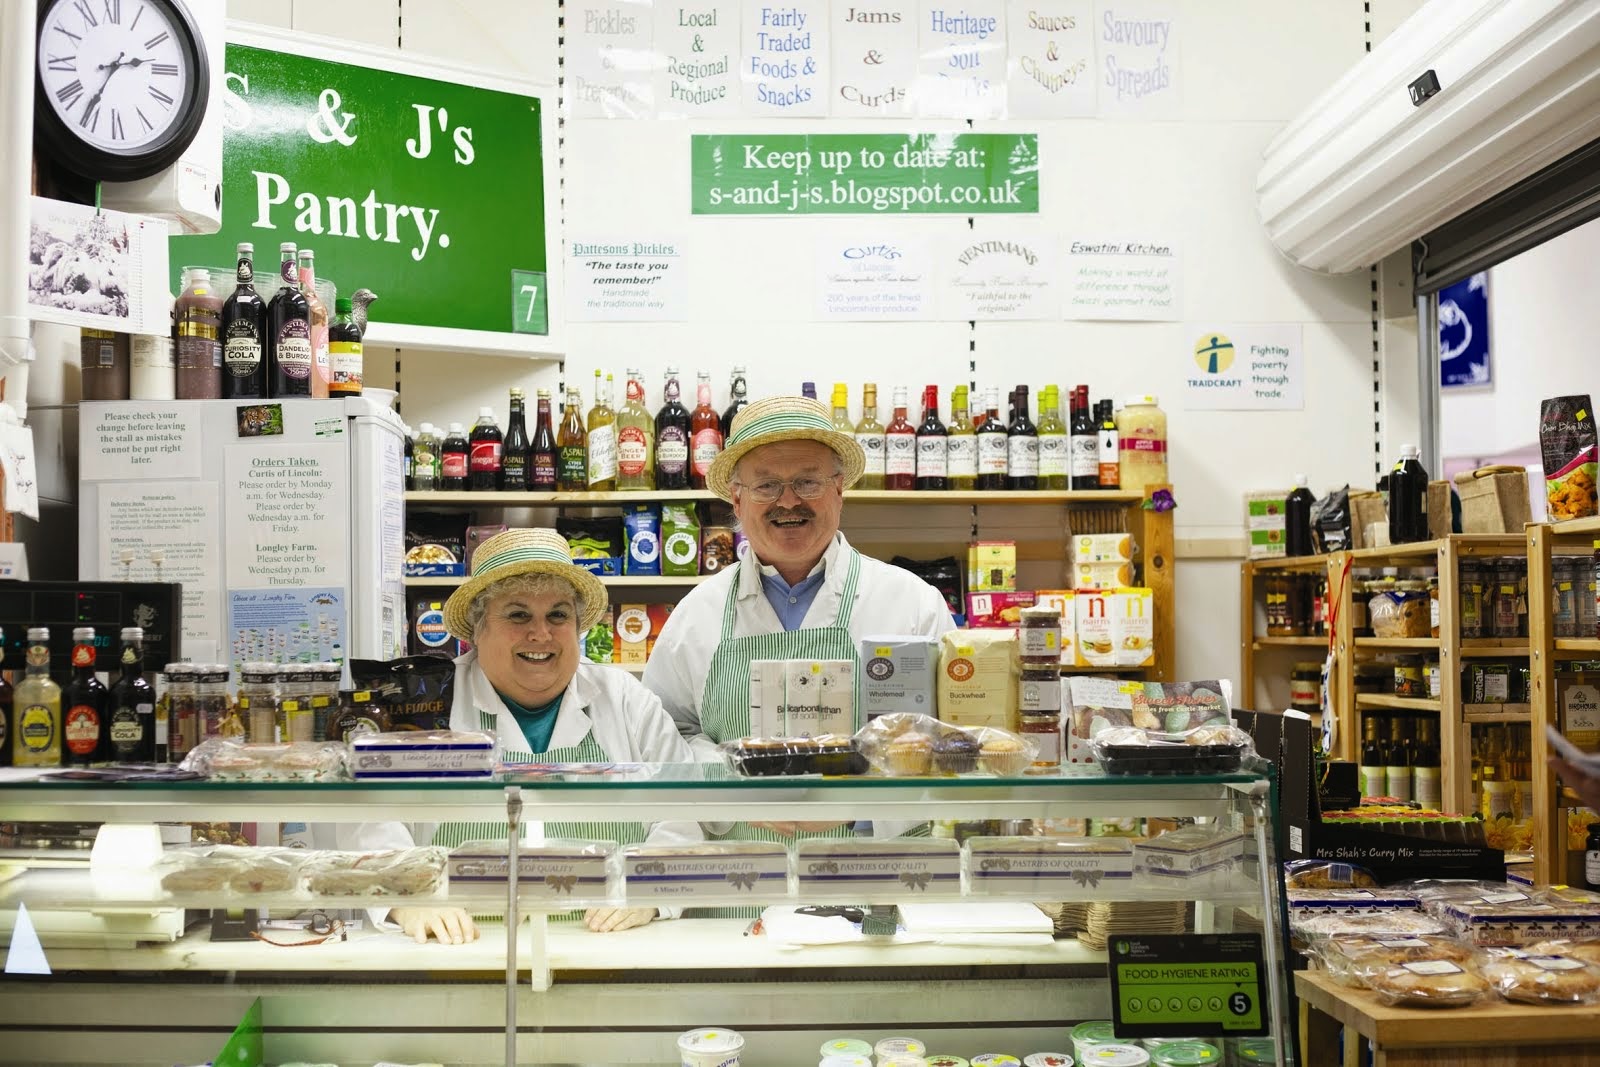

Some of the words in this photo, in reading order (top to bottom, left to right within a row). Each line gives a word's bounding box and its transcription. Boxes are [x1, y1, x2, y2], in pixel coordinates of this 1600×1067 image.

[679, 9, 717, 27] Local
[761, 8, 807, 31] Fairly
[845, 7, 902, 24] Jams
[1028, 11, 1076, 32] Sauces
[584, 9, 635, 35] Pickles
[931, 10, 996, 40] Heritage
[1103, 10, 1171, 52] Savoury
[692, 35, 704, 52] &
[757, 32, 811, 52] Traded
[1046, 40, 1060, 61] &
[863, 49, 885, 65] &
[668, 56, 729, 83] Regional
[751, 56, 797, 79] Foods
[802, 60, 816, 76] &
[1020, 55, 1087, 94] Chutneys
[1105, 55, 1169, 99] Spreads
[671, 80, 726, 106] Produce
[757, 83, 811, 107] Snacks
[840, 85, 906, 108] Curds
[223, 71, 251, 130] S
[306, 88, 358, 146] &
[405, 103, 475, 166] J's
[743, 144, 811, 175] Keep
[820, 152, 852, 175] up
[860, 147, 885, 168] to
[893, 144, 947, 168] date
[954, 147, 986, 168] at:
[710, 178, 1021, 211] s-and-j-s.blogspot.co.uk
[251, 170, 451, 261] Pantry.
[572, 243, 628, 255] Pattesons
[843, 244, 903, 260] Curtis
[957, 239, 1040, 267] FENTIMANS
[1071, 241, 1121, 253] Eswatini
[615, 261, 645, 271] taste
[649, 262, 669, 273] you
[1078, 267, 1112, 278] Making
[1127, 267, 1152, 277] world
[1156, 268, 1168, 279] of
[602, 287, 650, 297] Handmade
[1076, 281, 1128, 291] difference
[1134, 282, 1170, 294] through
[827, 293, 843, 302] 200
[847, 295, 869, 305] years
[872, 293, 880, 302] of
[882, 293, 896, 302] the
[898, 293, 921, 302] finest
[1009, 293, 1017, 301] to
[1019, 292, 1032, 301] the
[1103, 297, 1143, 307] gourmet
[520, 285, 538, 322] 7
[587, 299, 601, 309] the
[603, 298, 646, 309] traditional
[648, 301, 665, 310] way
[829, 303, 880, 313] Lincolnshire
[229, 351, 255, 359] COLA
[1250, 345, 1290, 358] Fighting
[1252, 362, 1288, 372] poverty
[1187, 379, 1243, 388] TRAIDCRAFT
[1252, 375, 1290, 387] through
[1255, 388, 1287, 398] trade.
[105, 412, 130, 420] Please
[132, 412, 156, 420] check
[157, 412, 178, 421] your
[96, 424, 126, 432] change
[128, 423, 154, 431] before
[156, 423, 185, 432] leaving
[100, 434, 114, 442] the
[146, 434, 182, 442] mistakes
[132, 445, 142, 453] be
[144, 446, 158, 454] put
[160, 445, 181, 453] right
[561, 447, 585, 459] ASPALL
[131, 456, 152, 464] later.
[252, 458, 285, 467] Orders
[288, 458, 319, 467] Taken.
[503, 456, 525, 467] ASPALL
[248, 470, 276, 478] Curtis
[277, 469, 287, 478] of
[288, 469, 322, 478] Lincoln:
[239, 481, 264, 490] Please
[265, 481, 287, 489] order
[288, 481, 299, 490] by
[300, 481, 333, 490] Monday
[265, 492, 277, 500] for
[279, 492, 325, 501] Wednesday.
[256, 503, 281, 511] Please
[282, 502, 304, 510] order
[306, 502, 316, 512] by
[247, 514, 292, 523] Wednesday
[312, 513, 325, 521] for
[272, 525, 300, 534] Friday.
[256, 544, 289, 553] Longley
[291, 544, 318, 552] Farm.
[256, 555, 282, 563] Please
[284, 554, 305, 562] order
[306, 554, 317, 563] by
[248, 566, 292, 574] Wednesday
[294, 566, 312, 575] p.m.
[313, 565, 326, 574] for
[267, 576, 305, 585] Thursday.
[977, 598, 986, 610] n
[1089, 597, 1105, 618] n
[1127, 597, 1143, 618] n
[1133, 694, 1175, 705] Sweet
[406, 701, 445, 714] FUDGE
[1198, 704, 1221, 712] Market
[1316, 848, 1334, 858] Mrs
[1336, 847, 1367, 859] Shah's
[1368, 848, 1395, 861] Curry
[1398, 847, 1414, 857] Mix
[524, 863, 536, 872] OF
[537, 863, 574, 874] QUALITY
[667, 863, 704, 872] PASTRIES
[705, 863, 717, 871] OF
[718, 862, 755, 872] QUALITY
[840, 862, 878, 871] PASTRIES
[878, 862, 890, 871] OF
[891, 861, 929, 871] QUALITY
[1012, 860, 1049, 868] PASTRIES
[1050, 860, 1062, 868] OF
[1063, 859, 1101, 869] QUALITY
[1125, 969, 1158, 979] FOOD
[1161, 969, 1209, 979] HYGIENE
[1211, 968, 1250, 978] RATING
[1235, 995, 1247, 1013] 5
